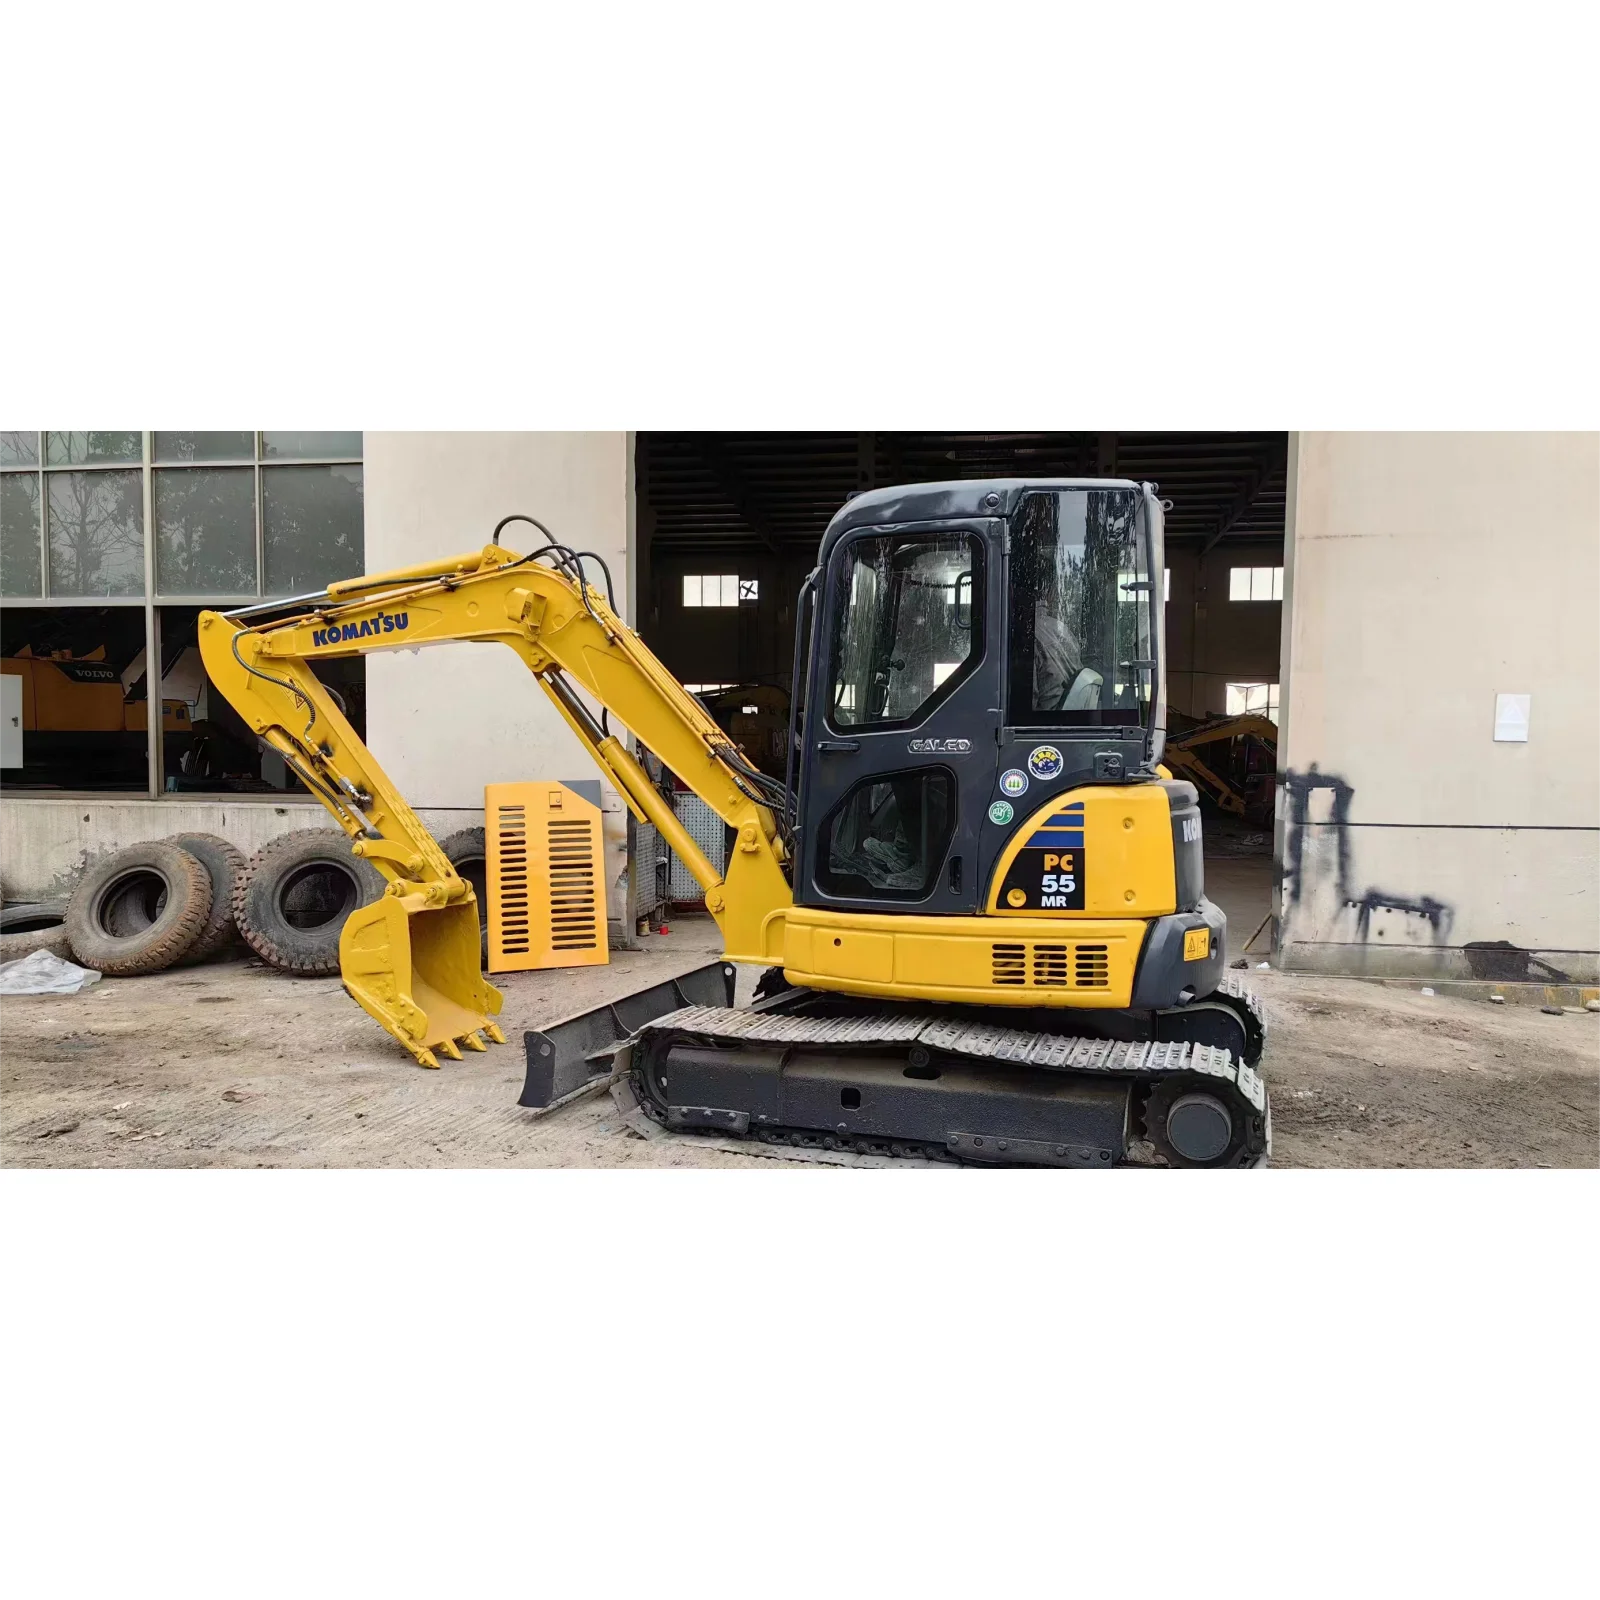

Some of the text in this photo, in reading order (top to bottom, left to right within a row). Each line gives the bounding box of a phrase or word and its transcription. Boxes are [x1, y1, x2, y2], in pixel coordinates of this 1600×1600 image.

[312, 612, 408, 647] KOMATSU
[74, 669, 114, 678] VOLVO
[1044, 854, 1073, 871] PC
[1041, 874, 1076, 893] 55
[1041, 895, 1067, 907] MR
